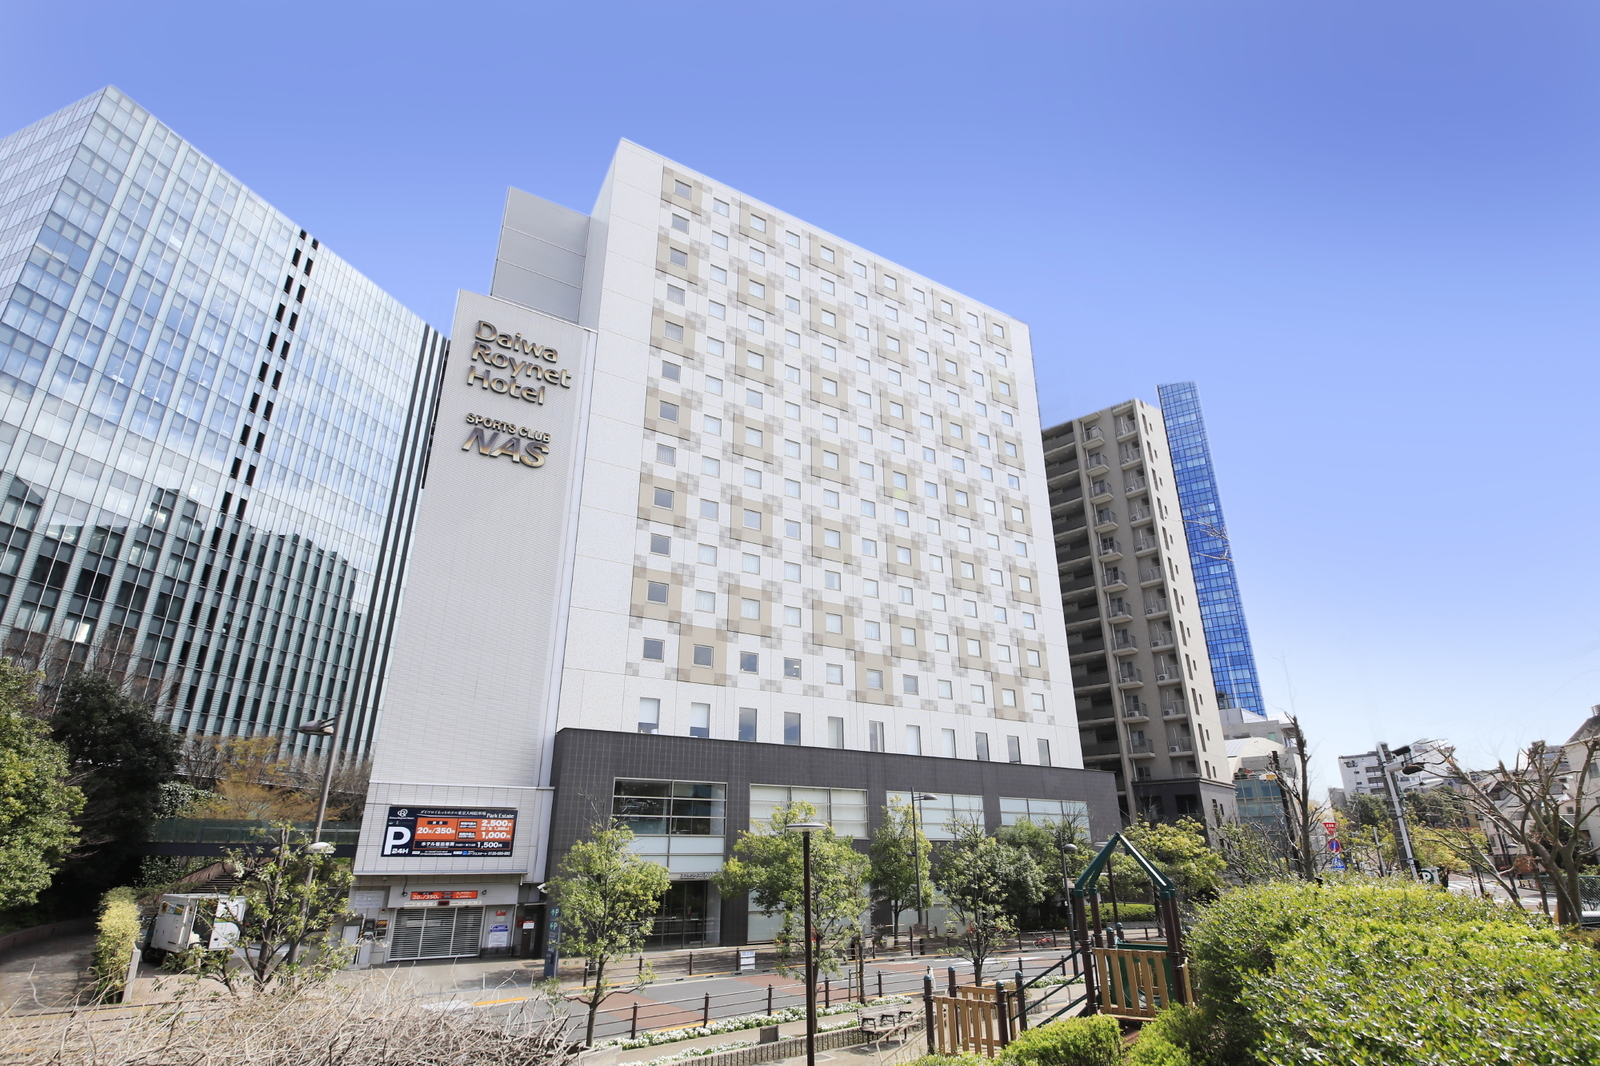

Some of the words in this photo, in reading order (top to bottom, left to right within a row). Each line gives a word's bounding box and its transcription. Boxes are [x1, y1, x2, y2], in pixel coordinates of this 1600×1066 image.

[474, 320, 558, 363] Daiwa
[471, 341, 572, 389] Roynet
[467, 365, 546, 405] Hotel
[466, 413, 517, 435] SPORTS
[518, 425, 551, 443] CLUB
[461, 427, 550, 468] NAS
[383, 826, 411, 855] P
[553, 922, 558, 931] P
[555, 908, 560, 917] P
